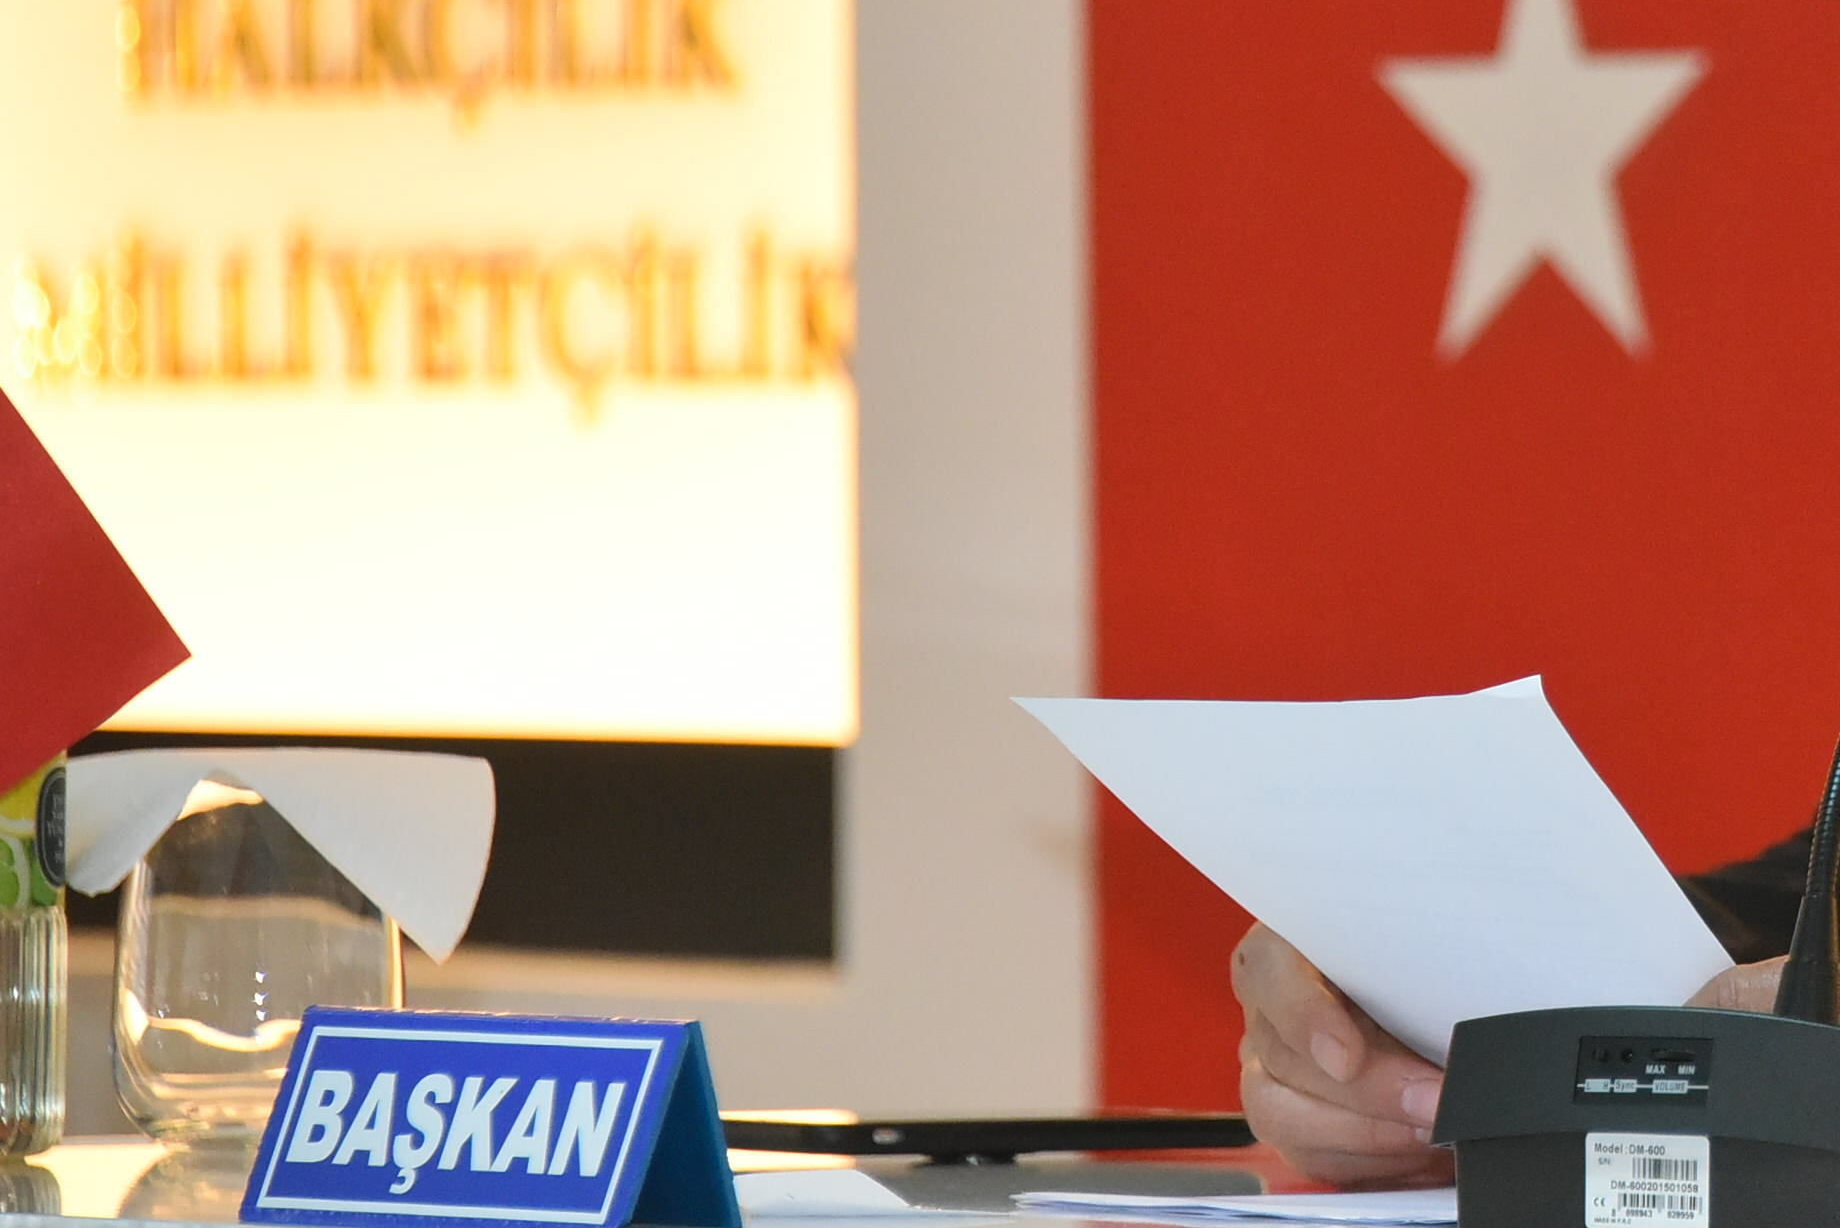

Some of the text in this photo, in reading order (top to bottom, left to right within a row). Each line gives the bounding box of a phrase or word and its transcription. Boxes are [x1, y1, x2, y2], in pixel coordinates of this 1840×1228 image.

[1645, 1064, 1696, 1075] MAX MIN
[1615, 1080, 1635, 1091] Sync
[1655, 1081, 1685, 1092] VOLUME
[286, 1069, 626, 1195] BAŞKAN
[1610, 1180, 1699, 1193] DM-600201501058
